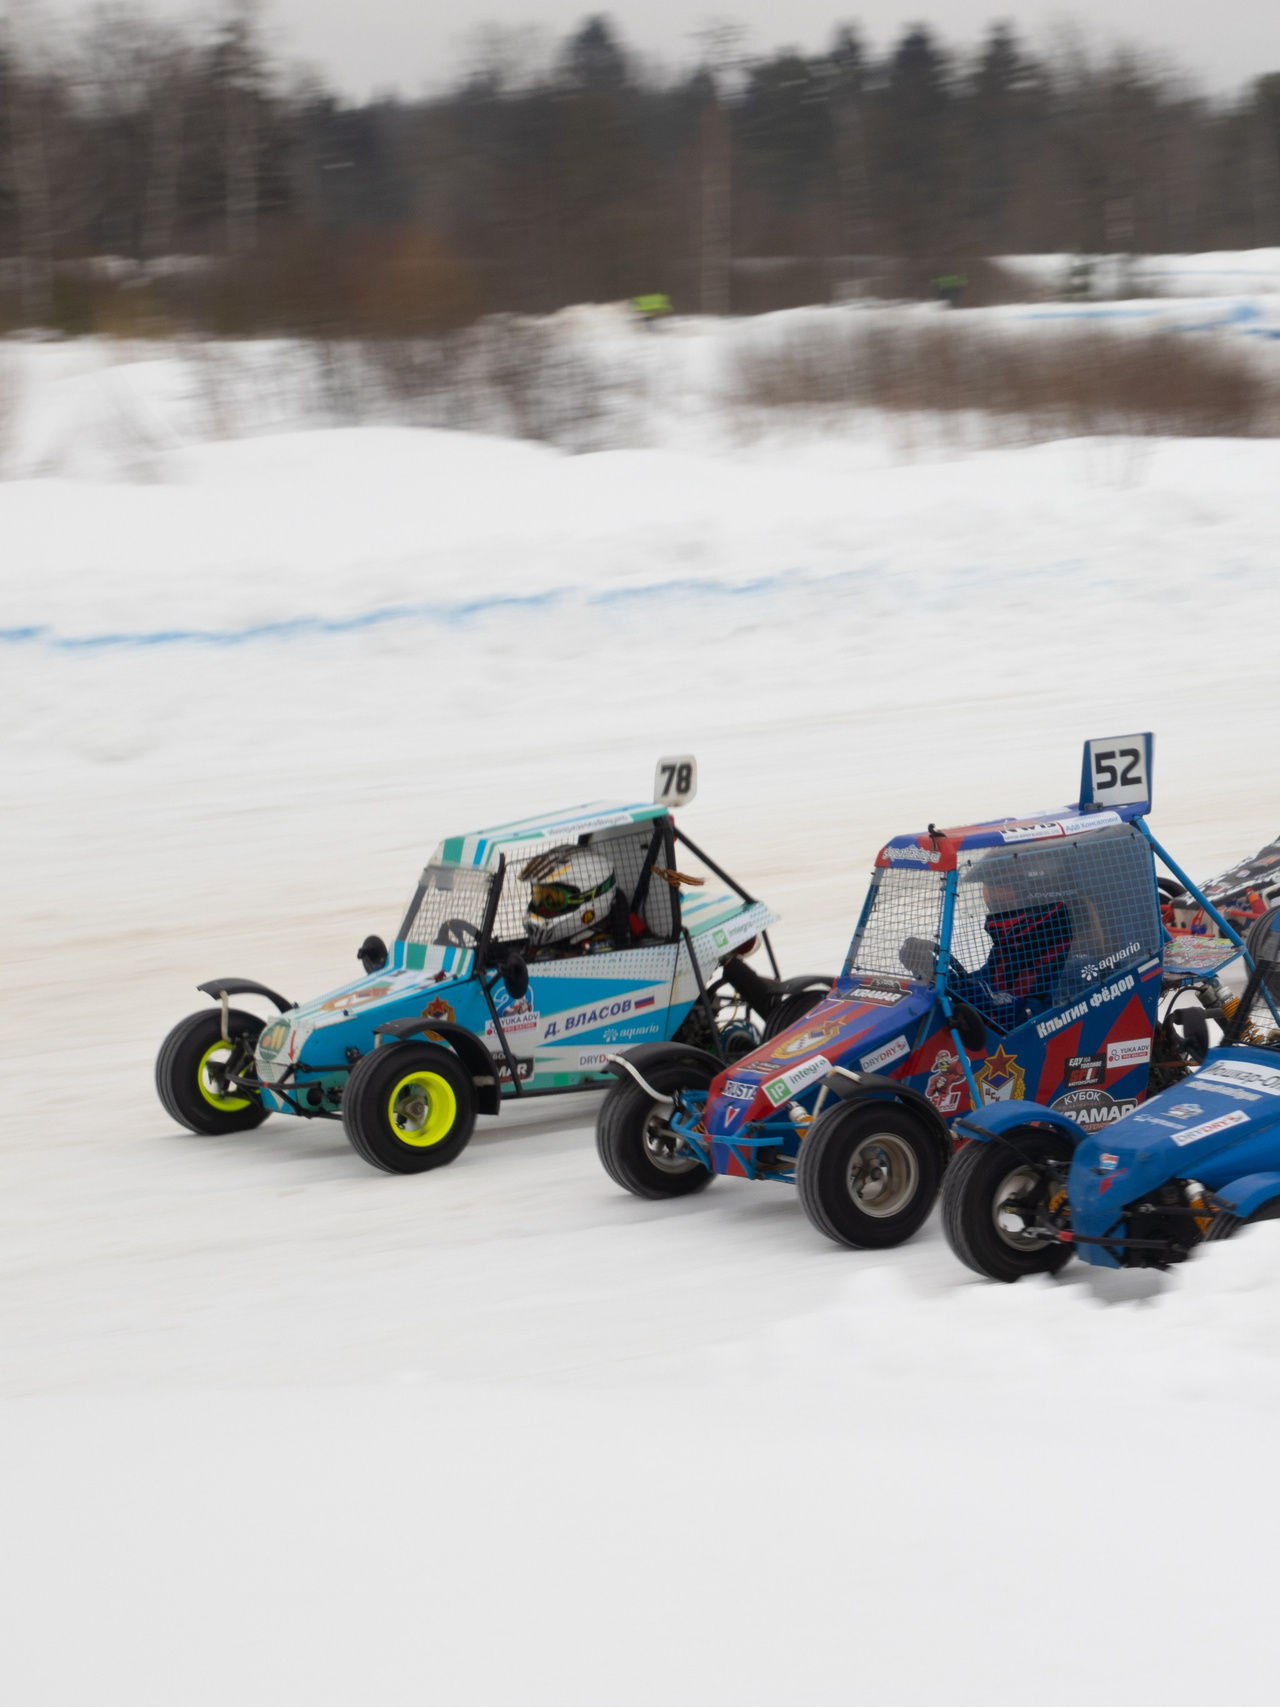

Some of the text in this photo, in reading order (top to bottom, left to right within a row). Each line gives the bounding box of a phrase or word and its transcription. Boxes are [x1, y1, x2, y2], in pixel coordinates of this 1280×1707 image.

[1094, 747, 1143, 791] 52
[660, 763, 692, 797] 78
[1098, 941, 1141, 970] aquario
[850, 988, 903, 1003] KRAMAR
[1089, 974, 1136, 1007] Фёдор
[501, 1013, 539, 1026] YUKA ADV
[564, 999, 633, 1031] ВЛАСОВ
[619, 1024, 660, 1039] aquario
[1120, 1044, 1150, 1055] YUKA ADV
[789, 1058, 828, 1085] integra
[1069, 1057, 1084, 1067] ЕДУ
[725, 1080, 758, 1099] RUSTA
[1063, 1090, 1102, 1106] КУБОК
[1062, 1103, 1135, 1125] RAMAR
